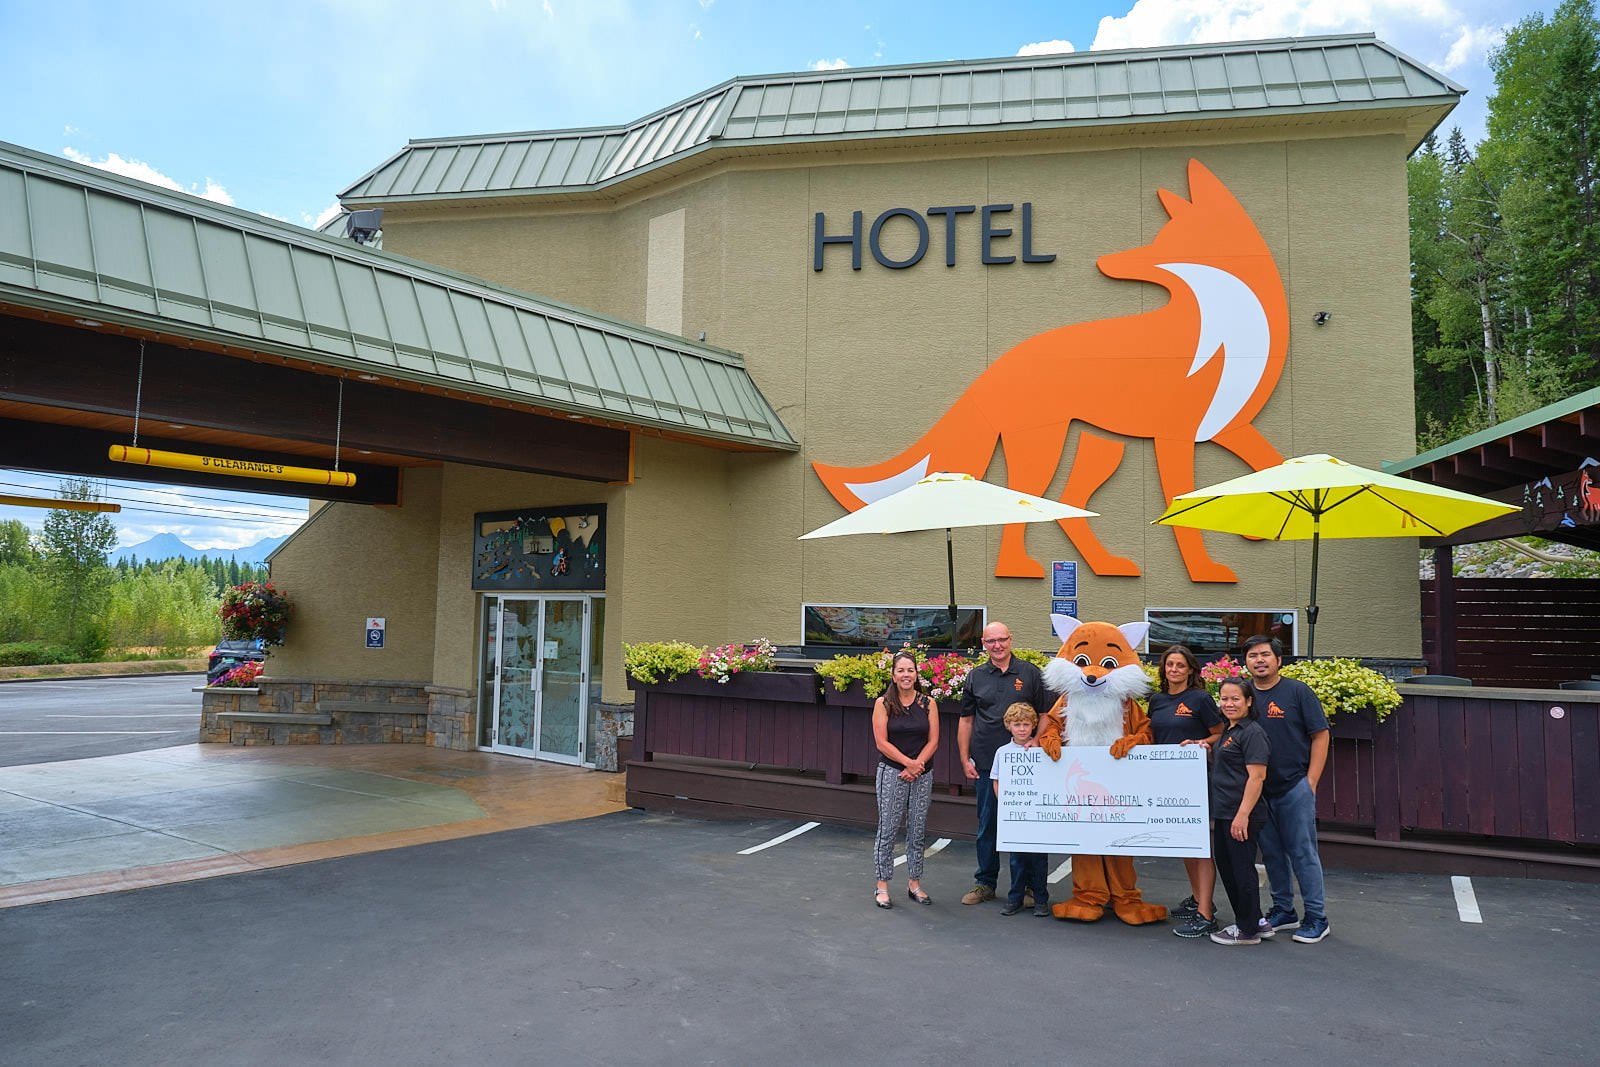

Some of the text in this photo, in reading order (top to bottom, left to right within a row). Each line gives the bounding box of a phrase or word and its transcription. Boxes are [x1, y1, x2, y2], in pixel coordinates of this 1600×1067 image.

[814, 202, 1057, 272] HOTEL
[213, 458, 274, 473] CLEARANCE
[1004, 752, 1041, 763] FERNIE
[1127, 750, 1198, 761] Date SEPT 2 2020
[1011, 765, 1034, 776] FOX
[1010, 778, 1034, 786] HOTEL
[1003, 790, 1016, 798] Pay
[1042, 793, 1060, 805] ELK
[1066, 794, 1098, 806] VALLEY
[1103, 794, 1141, 806] HOSPITAL
[1147, 798, 1153, 807] $
[1009, 811, 1027, 821] FIVE
[1036, 811, 1078, 822] THOUSAND
[1090, 812, 1126, 823] DOLLARS
